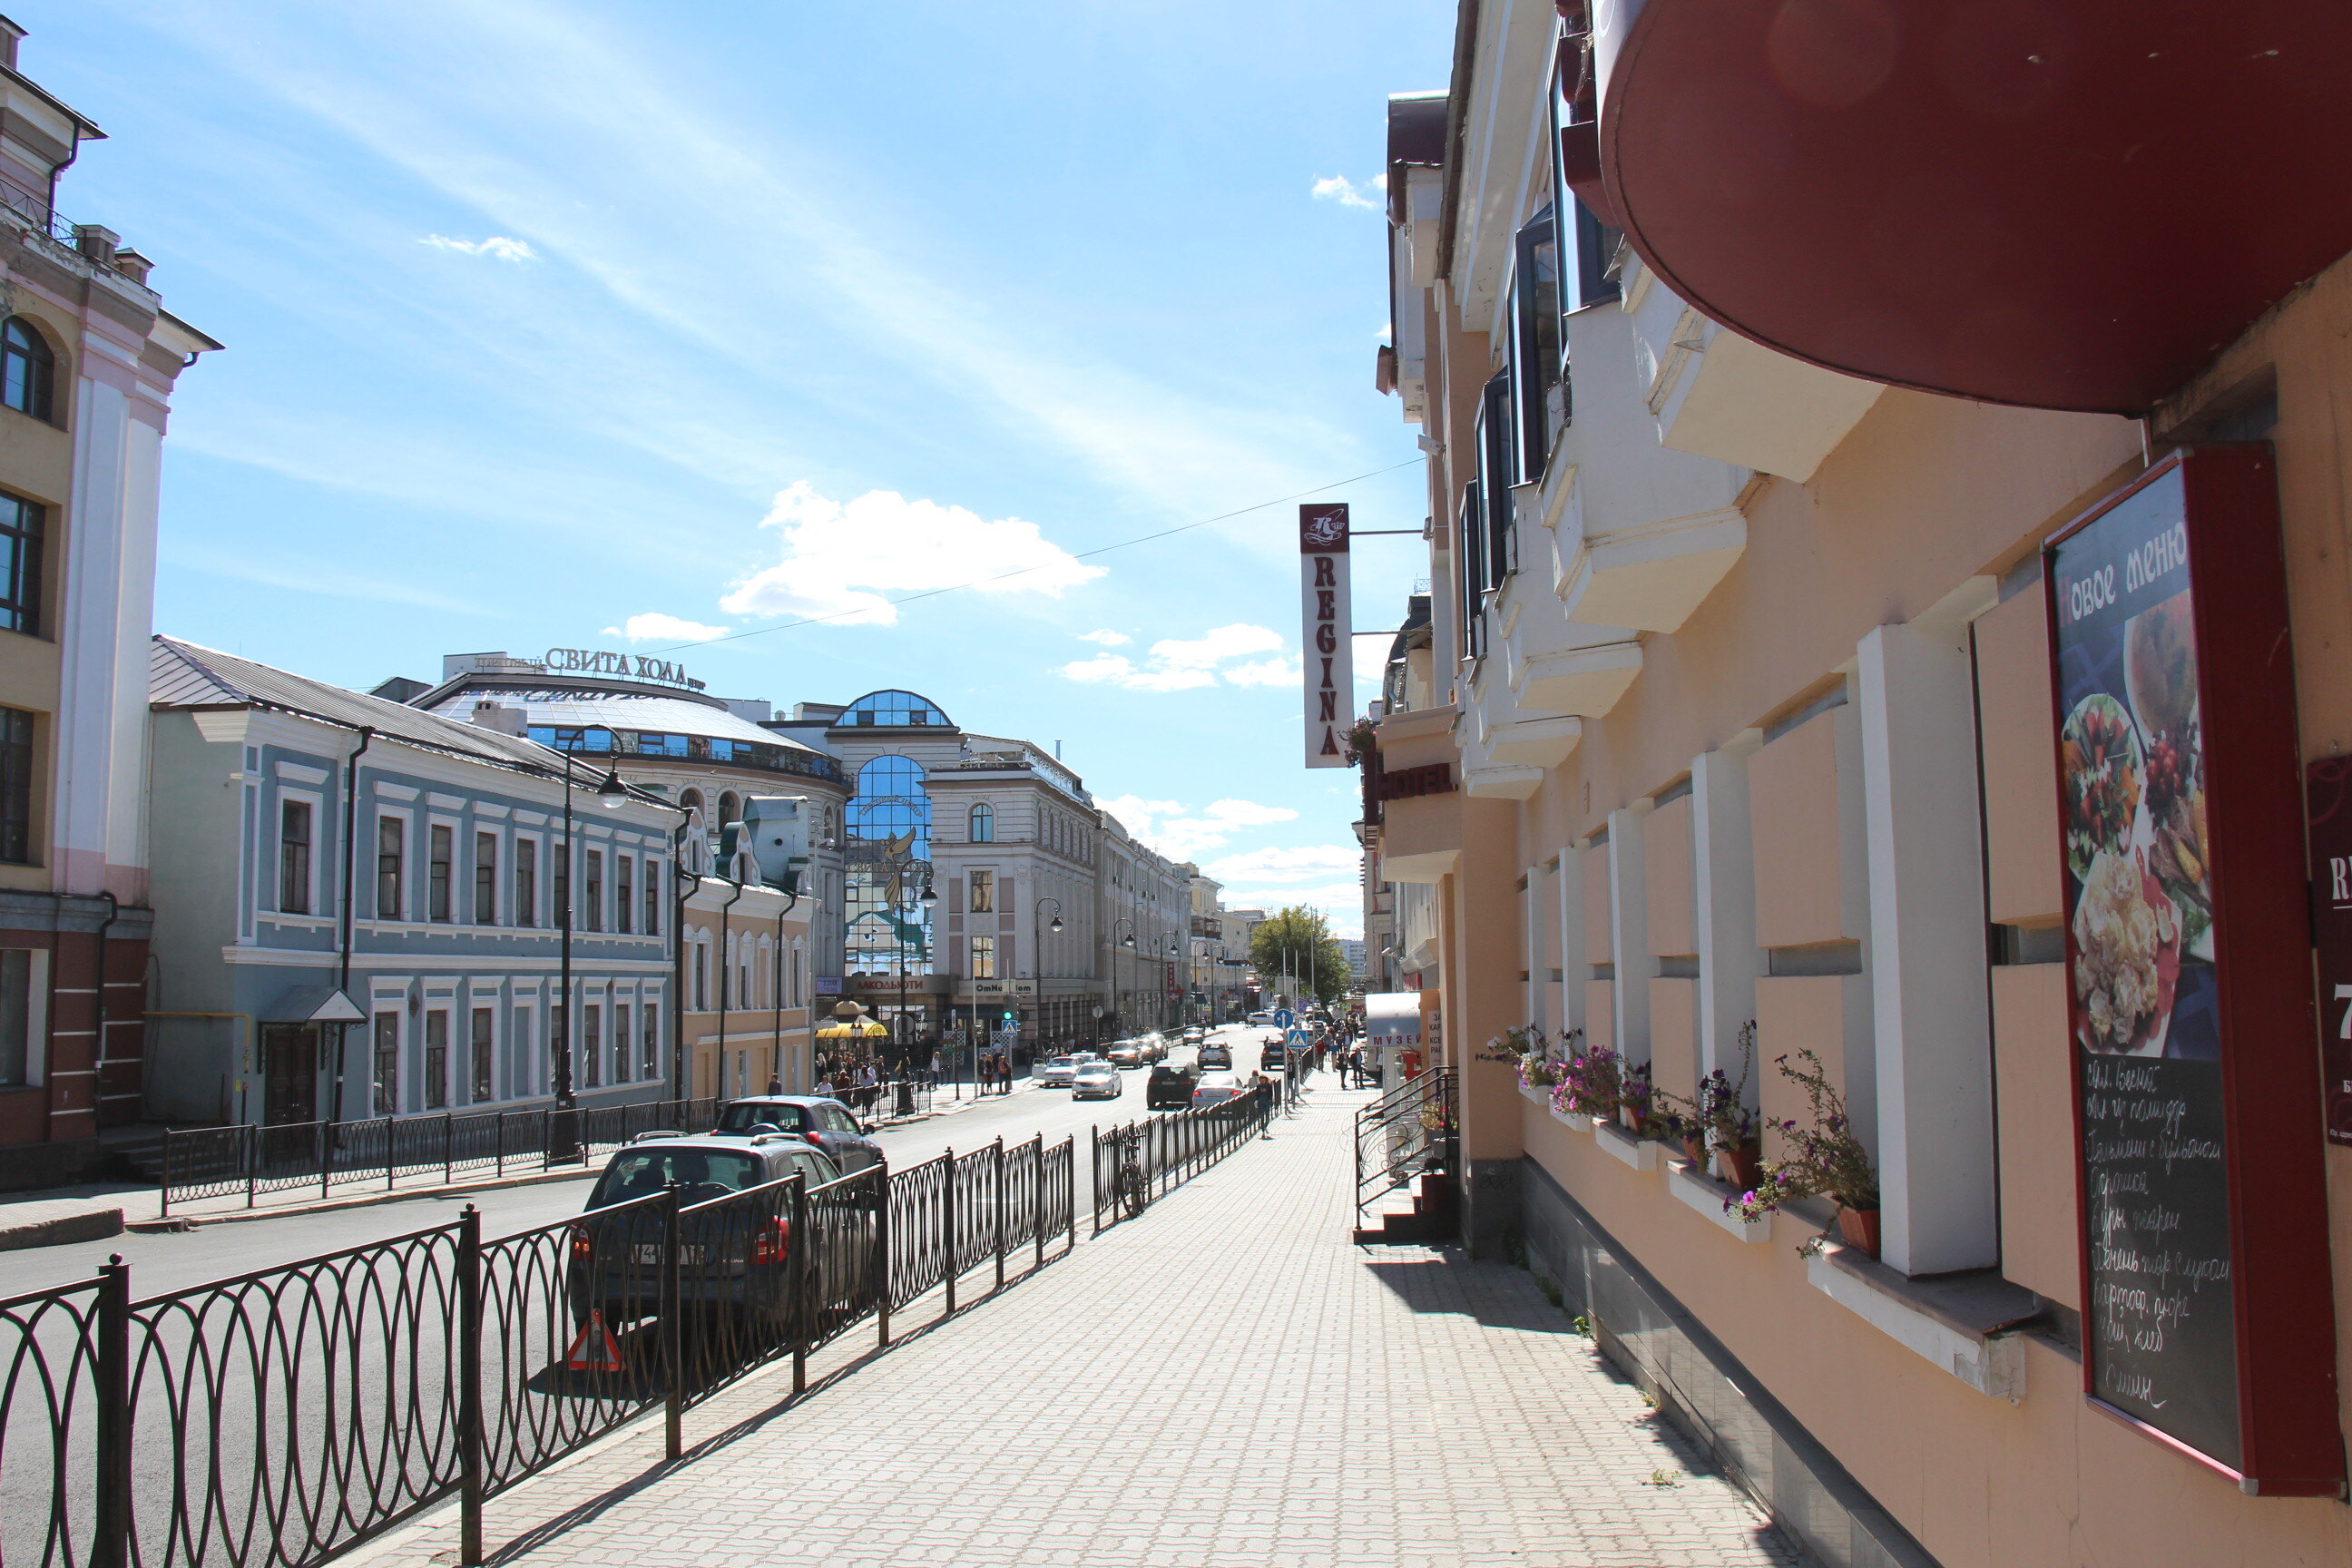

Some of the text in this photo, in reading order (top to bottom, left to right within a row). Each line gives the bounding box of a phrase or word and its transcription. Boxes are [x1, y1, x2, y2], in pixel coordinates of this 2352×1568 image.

[2126, 521, 2187, 594] меню
[545, 648, 632, 676] СВИТА
[1314, 556, 1339, 755] REGINA
[2329, 855, 2352, 900] R
[2343, 1080, 2352, 1093] Б
